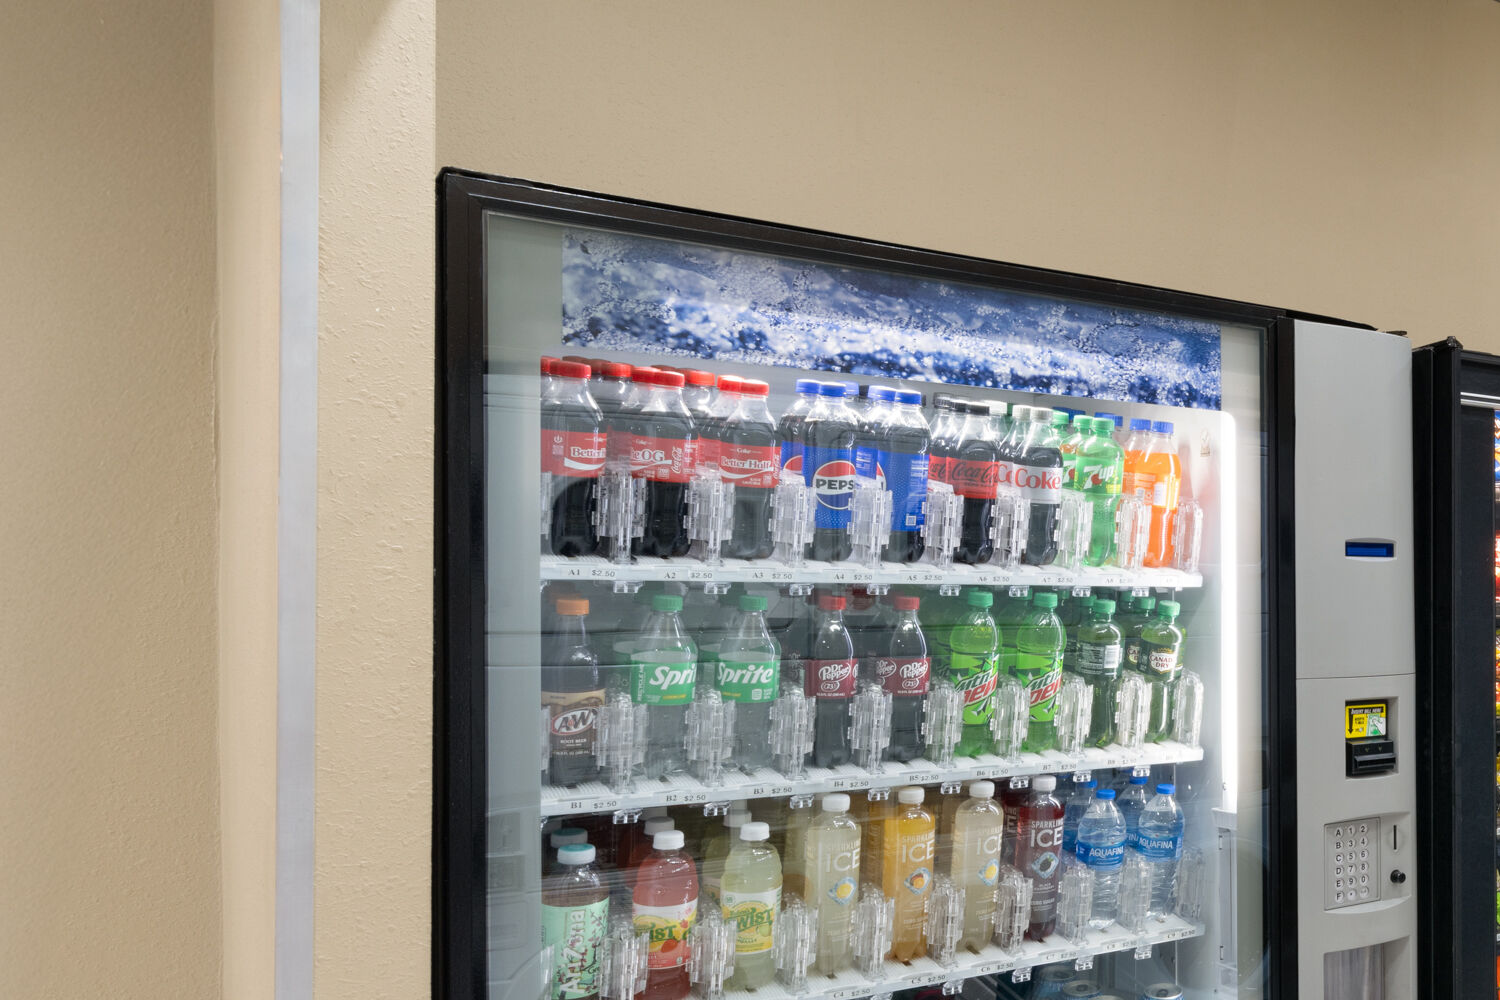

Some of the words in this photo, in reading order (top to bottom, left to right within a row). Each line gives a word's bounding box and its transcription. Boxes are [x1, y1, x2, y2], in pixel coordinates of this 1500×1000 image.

[641, 448, 665, 462] OG
[671, 446, 683, 474] Coca-Cola
[720, 455, 746, 468] Better
[815, 478, 854, 490] PEPS
[1015, 467, 1060, 490] Coke
[591, 569, 615, 577] $2.50
[717, 663, 774, 686] Sprite
[558, 710, 591, 731] A&W
[594, 801, 617, 809] $2.50
[1031, 827, 1062, 848] ICE
[1139, 838, 1173, 849] AQUAFINA
[902, 840, 934, 863] ICE
[1089, 846, 1123, 859] AQUAFINA
[825, 849, 860, 873] ICE
[928, 974, 945, 982] $2.50
[852, 988, 870, 997] $2.50
